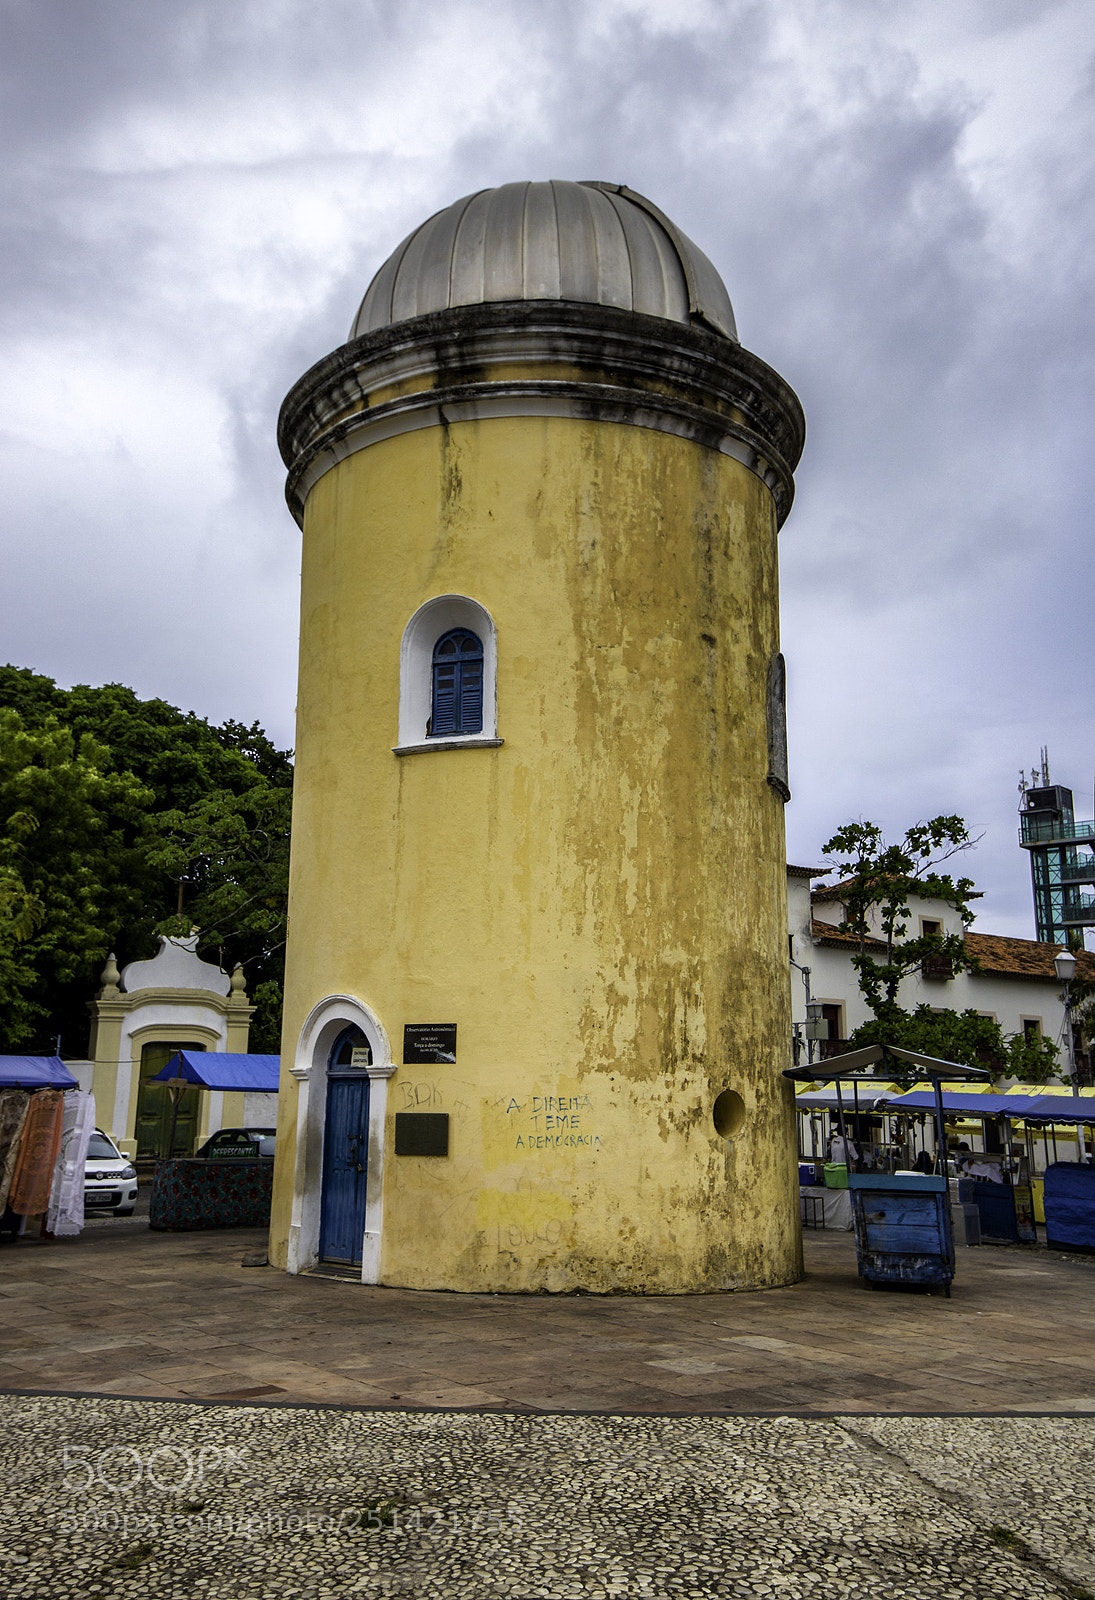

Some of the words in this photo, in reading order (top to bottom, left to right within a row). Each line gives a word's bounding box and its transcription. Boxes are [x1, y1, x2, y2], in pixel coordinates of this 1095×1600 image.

[506, 1098, 521, 1113] A
[532, 1095, 594, 1113] DIREITA
[530, 1114, 580, 1133] TEME
[515, 1134, 525, 1149] A
[528, 1134, 603, 1149] DEMOCRACIA
